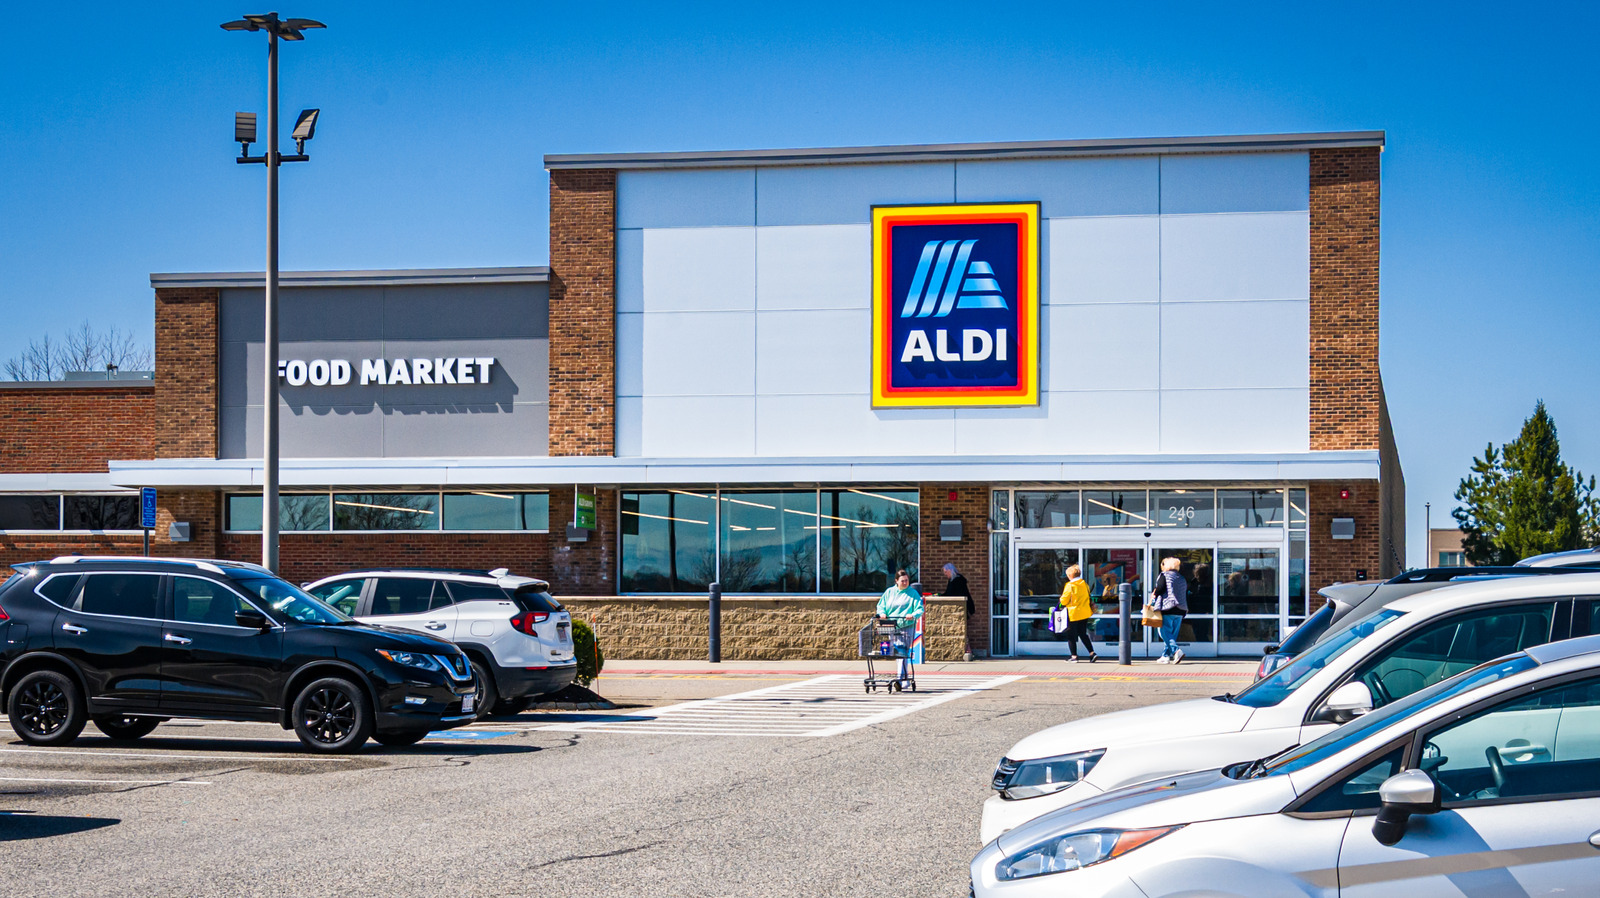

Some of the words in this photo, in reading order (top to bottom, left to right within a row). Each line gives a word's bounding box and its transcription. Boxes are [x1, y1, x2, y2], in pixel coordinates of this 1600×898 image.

[900, 328, 1008, 363] ALDI
[359, 357, 495, 386] MARKET
[1168, 506, 1195, 519] 246
